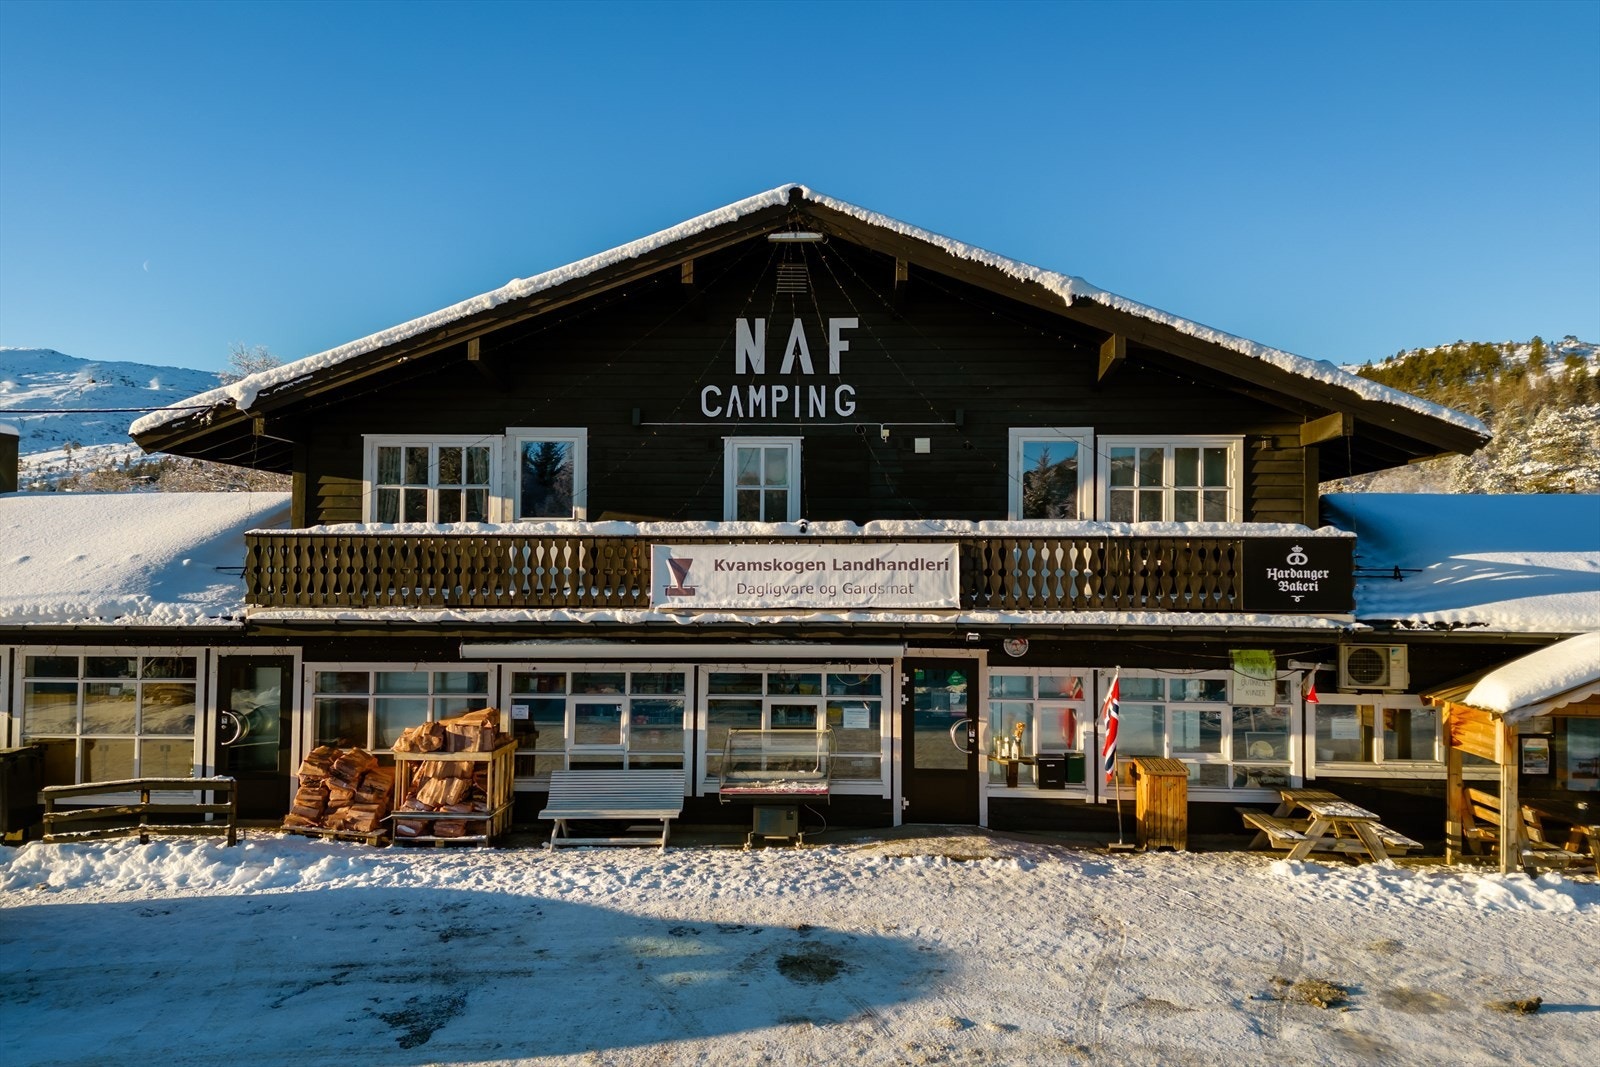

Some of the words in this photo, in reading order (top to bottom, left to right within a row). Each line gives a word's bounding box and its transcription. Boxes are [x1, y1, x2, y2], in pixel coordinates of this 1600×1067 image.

[735, 317, 859, 375] NAF
[701, 384, 856, 418] CAMPING
[714, 558, 826, 574] Kvamskogen
[832, 557, 949, 571] Landhandleri
[1266, 567, 1330, 581] Hardanger
[736, 582, 814, 597] Dagligvare
[819, 584, 837, 597] og
[1278, 580, 1319, 592] Bakeri
